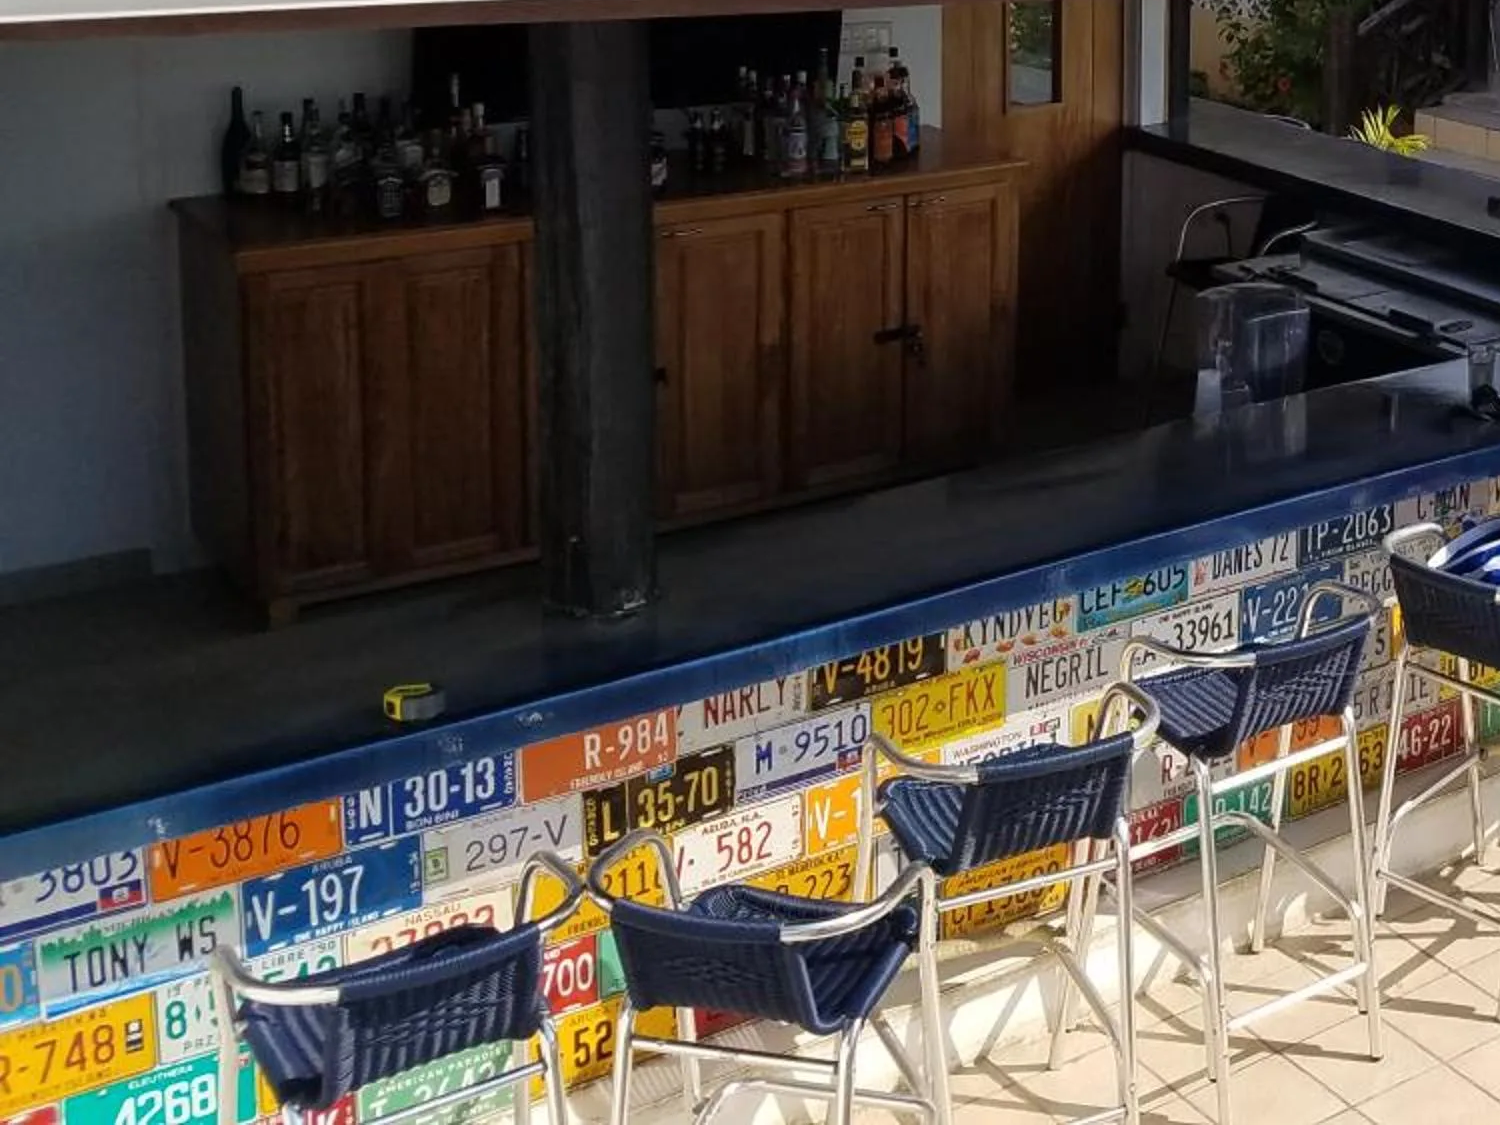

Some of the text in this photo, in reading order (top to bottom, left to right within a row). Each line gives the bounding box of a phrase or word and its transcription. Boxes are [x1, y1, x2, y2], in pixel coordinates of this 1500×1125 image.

[949, 674, 996, 722] FKX
[1025, 648, 1109, 699] NEGRIL
[583, 712, 668, 769] R-984
[794, 714, 867, 763] 9510
[404, 757, 496, 818] 30-13
[638, 766, 718, 828] 35-70
[465, 814, 567, 871] 297-V
[717, 821, 772, 873] 582
[252, 865, 364, 941] V-197
[405, 902, 462, 926] NASSAU
[64, 933, 148, 993] TONY
[575, 1020, 612, 1069] 52
